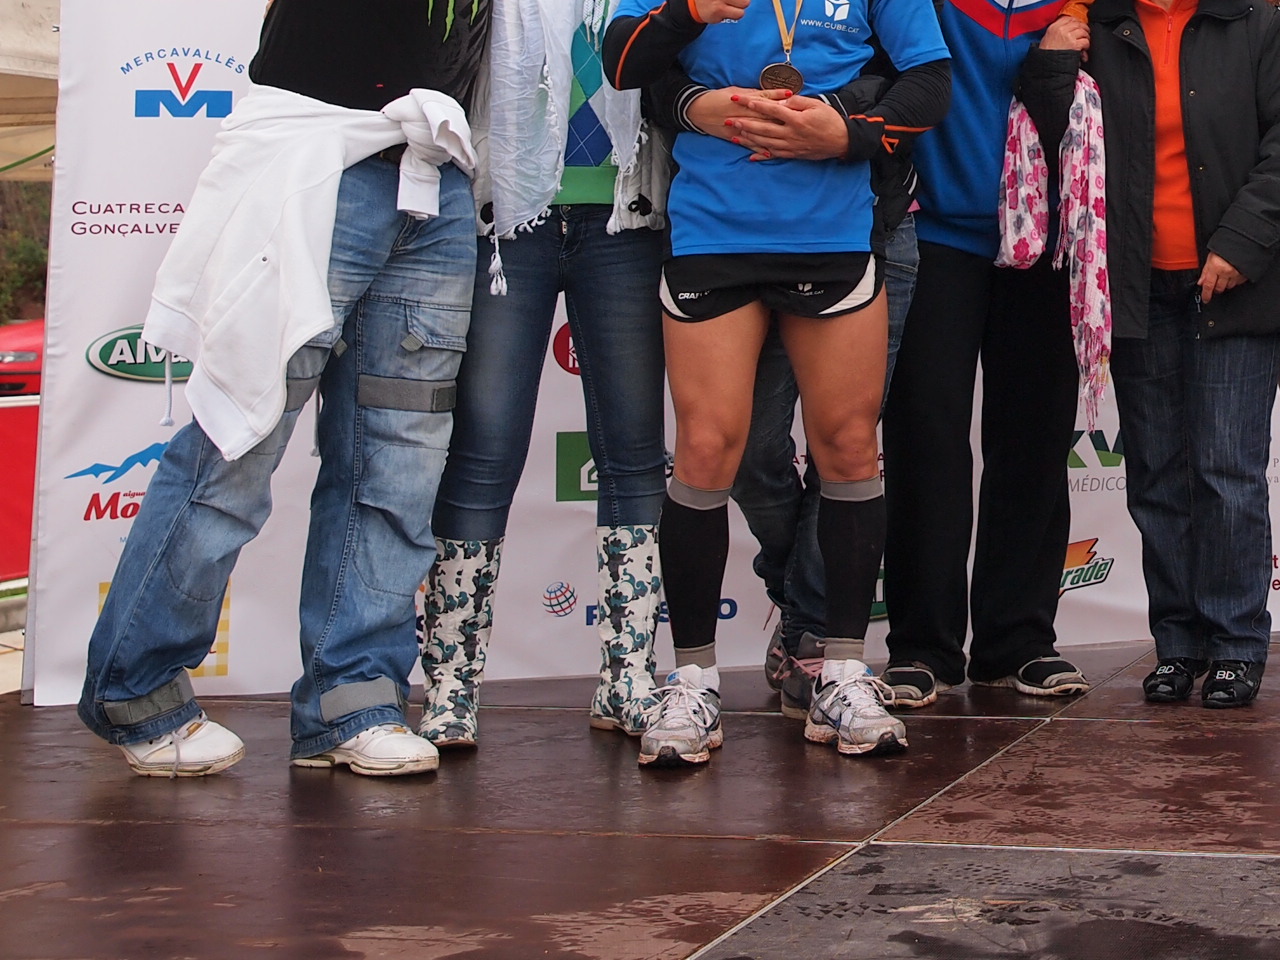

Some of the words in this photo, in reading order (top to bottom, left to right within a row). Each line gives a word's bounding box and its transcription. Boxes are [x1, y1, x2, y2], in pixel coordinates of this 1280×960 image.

[800, 18, 861, 34] WWW.CUBE.CAT
[120, 46, 246, 76] MERCAVALLÈS
[72, 201, 185, 215] CUATRECA
[71, 221, 181, 238] GONÇALVE
[83, 491, 141, 521] Mo
[1156, 665, 1175, 675] BD
[1216, 670, 1236, 681] BD
